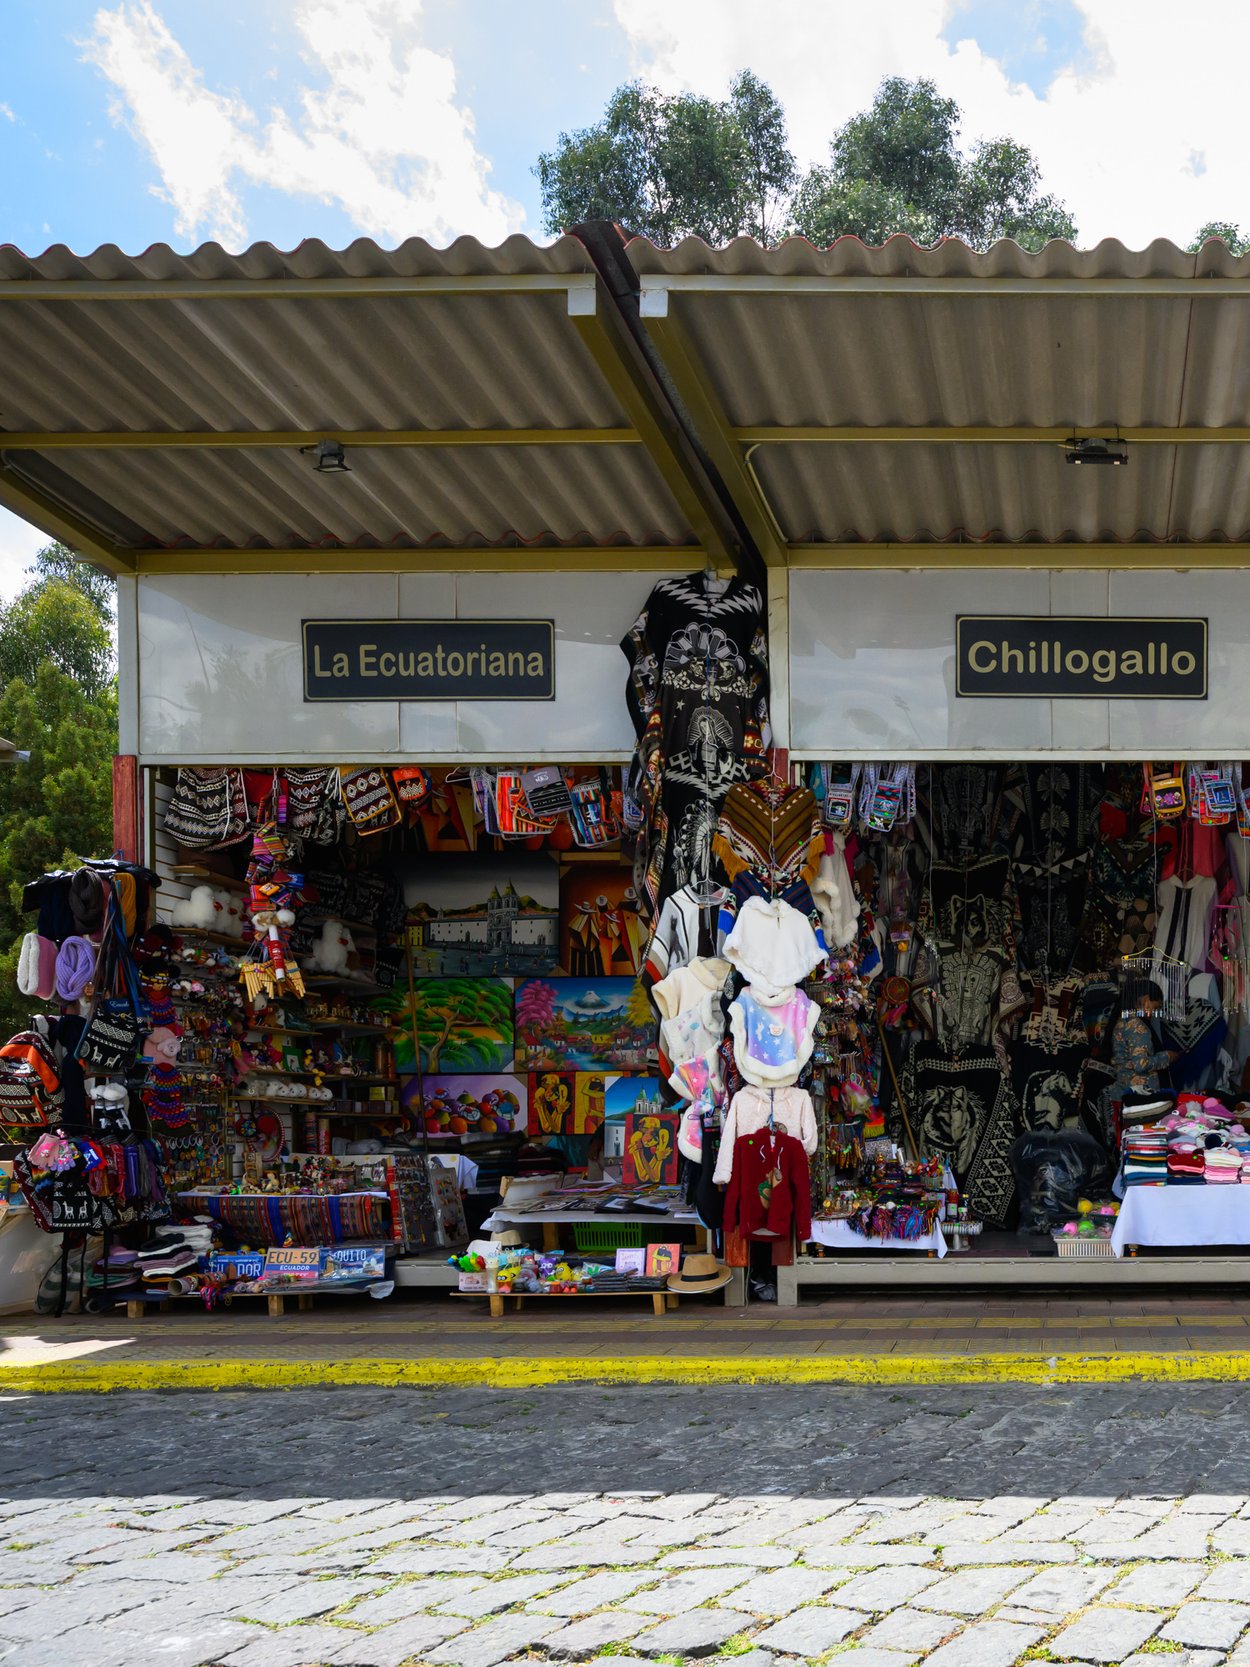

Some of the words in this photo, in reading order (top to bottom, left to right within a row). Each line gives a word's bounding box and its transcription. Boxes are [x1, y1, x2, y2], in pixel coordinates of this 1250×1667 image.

[314, 644, 350, 677] La
[359, 643, 544, 677] Ecuatoriana
[967, 640, 1196, 683] Chillogallo
[268, 1251, 320, 1264] ECU-59
